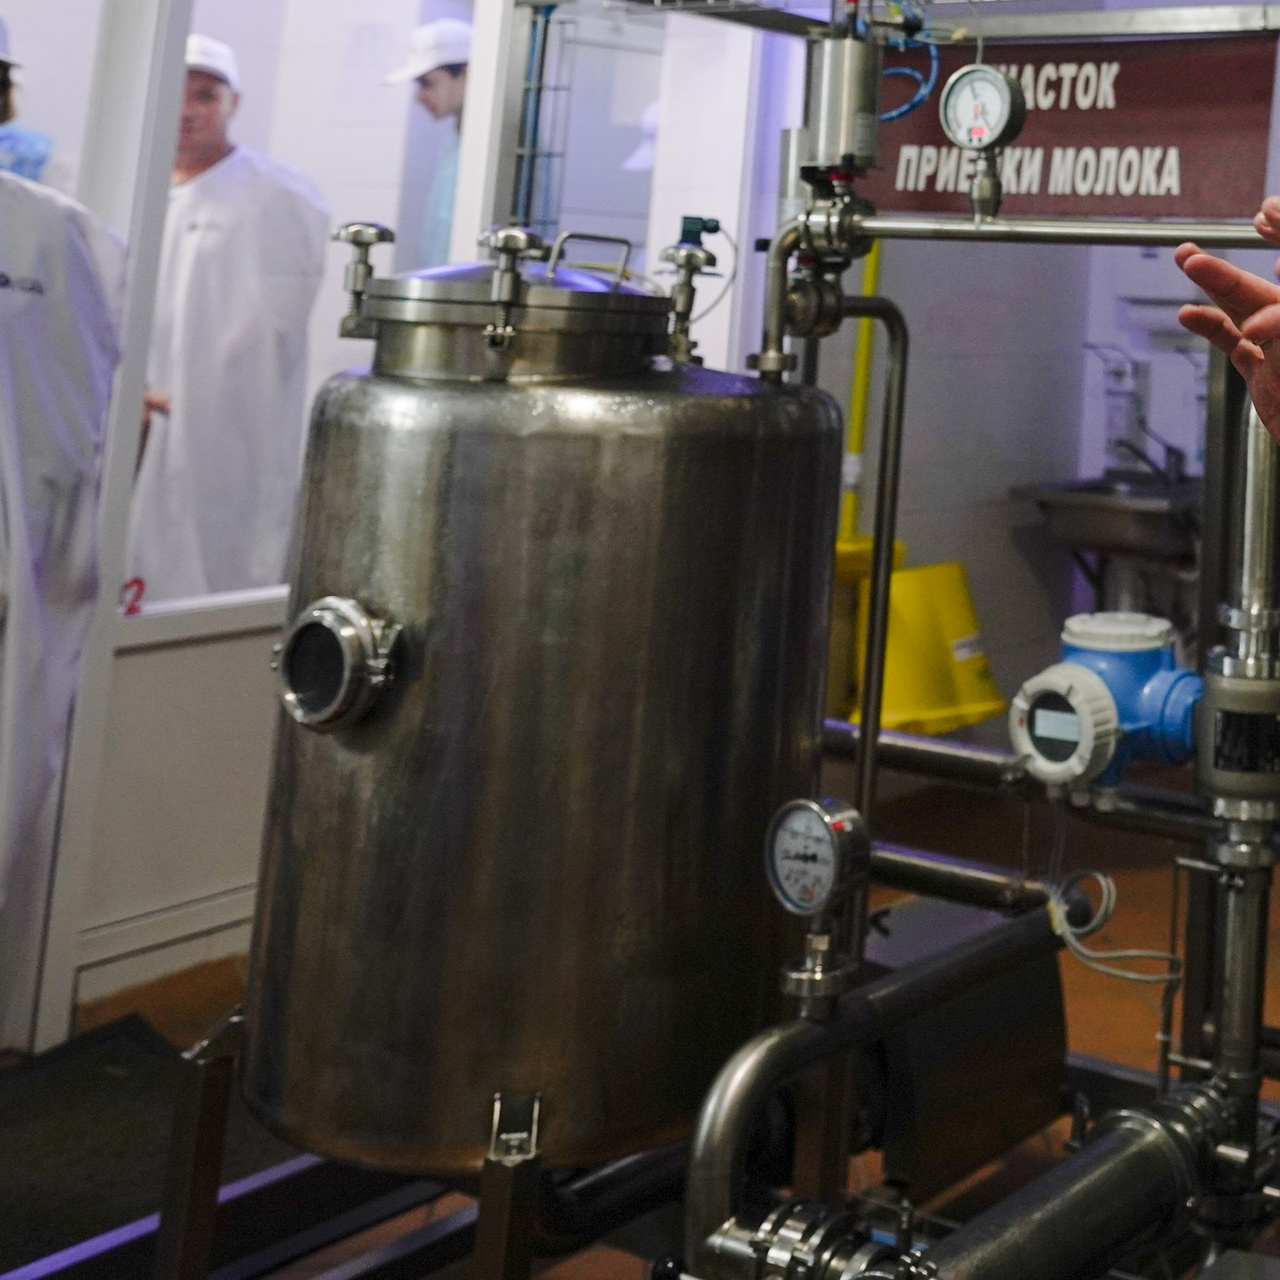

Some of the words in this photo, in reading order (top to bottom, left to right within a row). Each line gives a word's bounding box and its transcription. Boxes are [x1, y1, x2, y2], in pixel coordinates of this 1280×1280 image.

[998, 61, 1121, 111] АСТОК
[895, 144, 1044, 195] ПРИЕКИ
[1048, 145, 1181, 197] МОЛОКА
